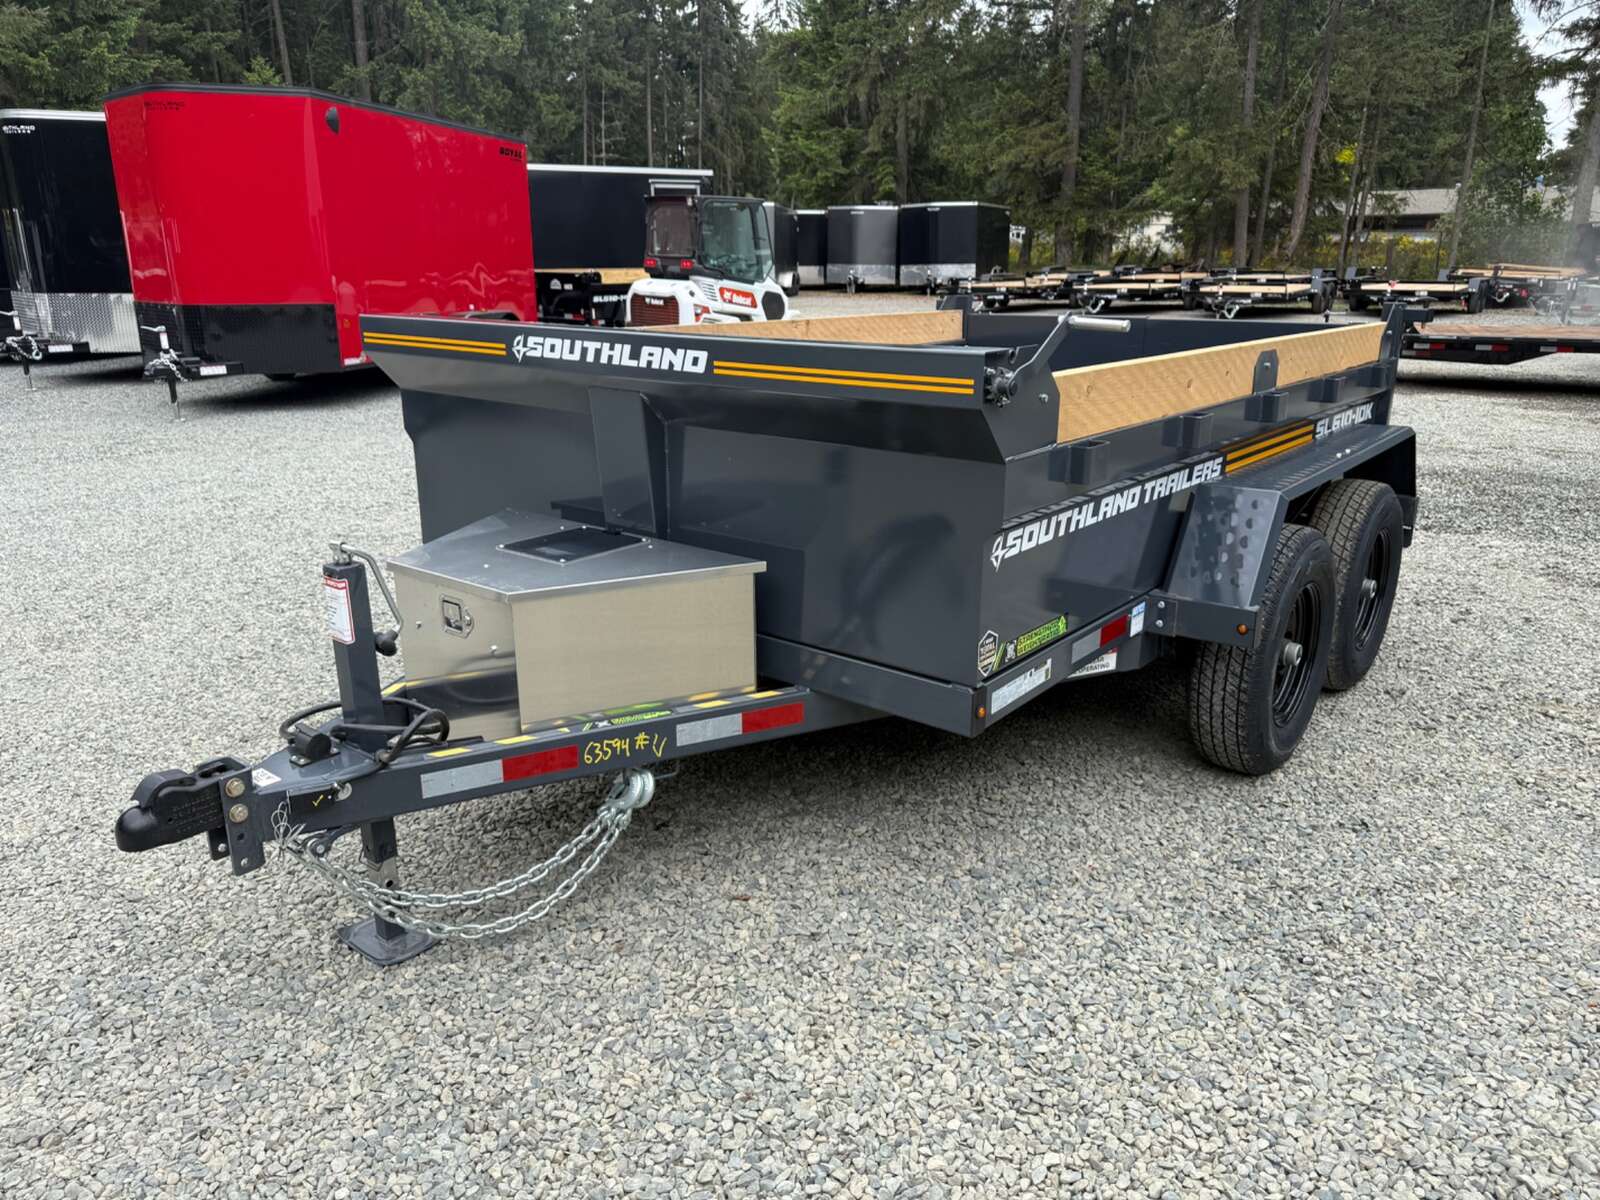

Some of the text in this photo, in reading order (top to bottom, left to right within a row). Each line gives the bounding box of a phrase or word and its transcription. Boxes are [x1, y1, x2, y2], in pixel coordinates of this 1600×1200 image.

[526, 335, 709, 374] SOUTHLAND
[1315, 402, 1375, 439] SL610-10K
[1004, 456, 1224, 560] SOUTHLAND TRAILERS
[584, 737, 631, 765] 63594
